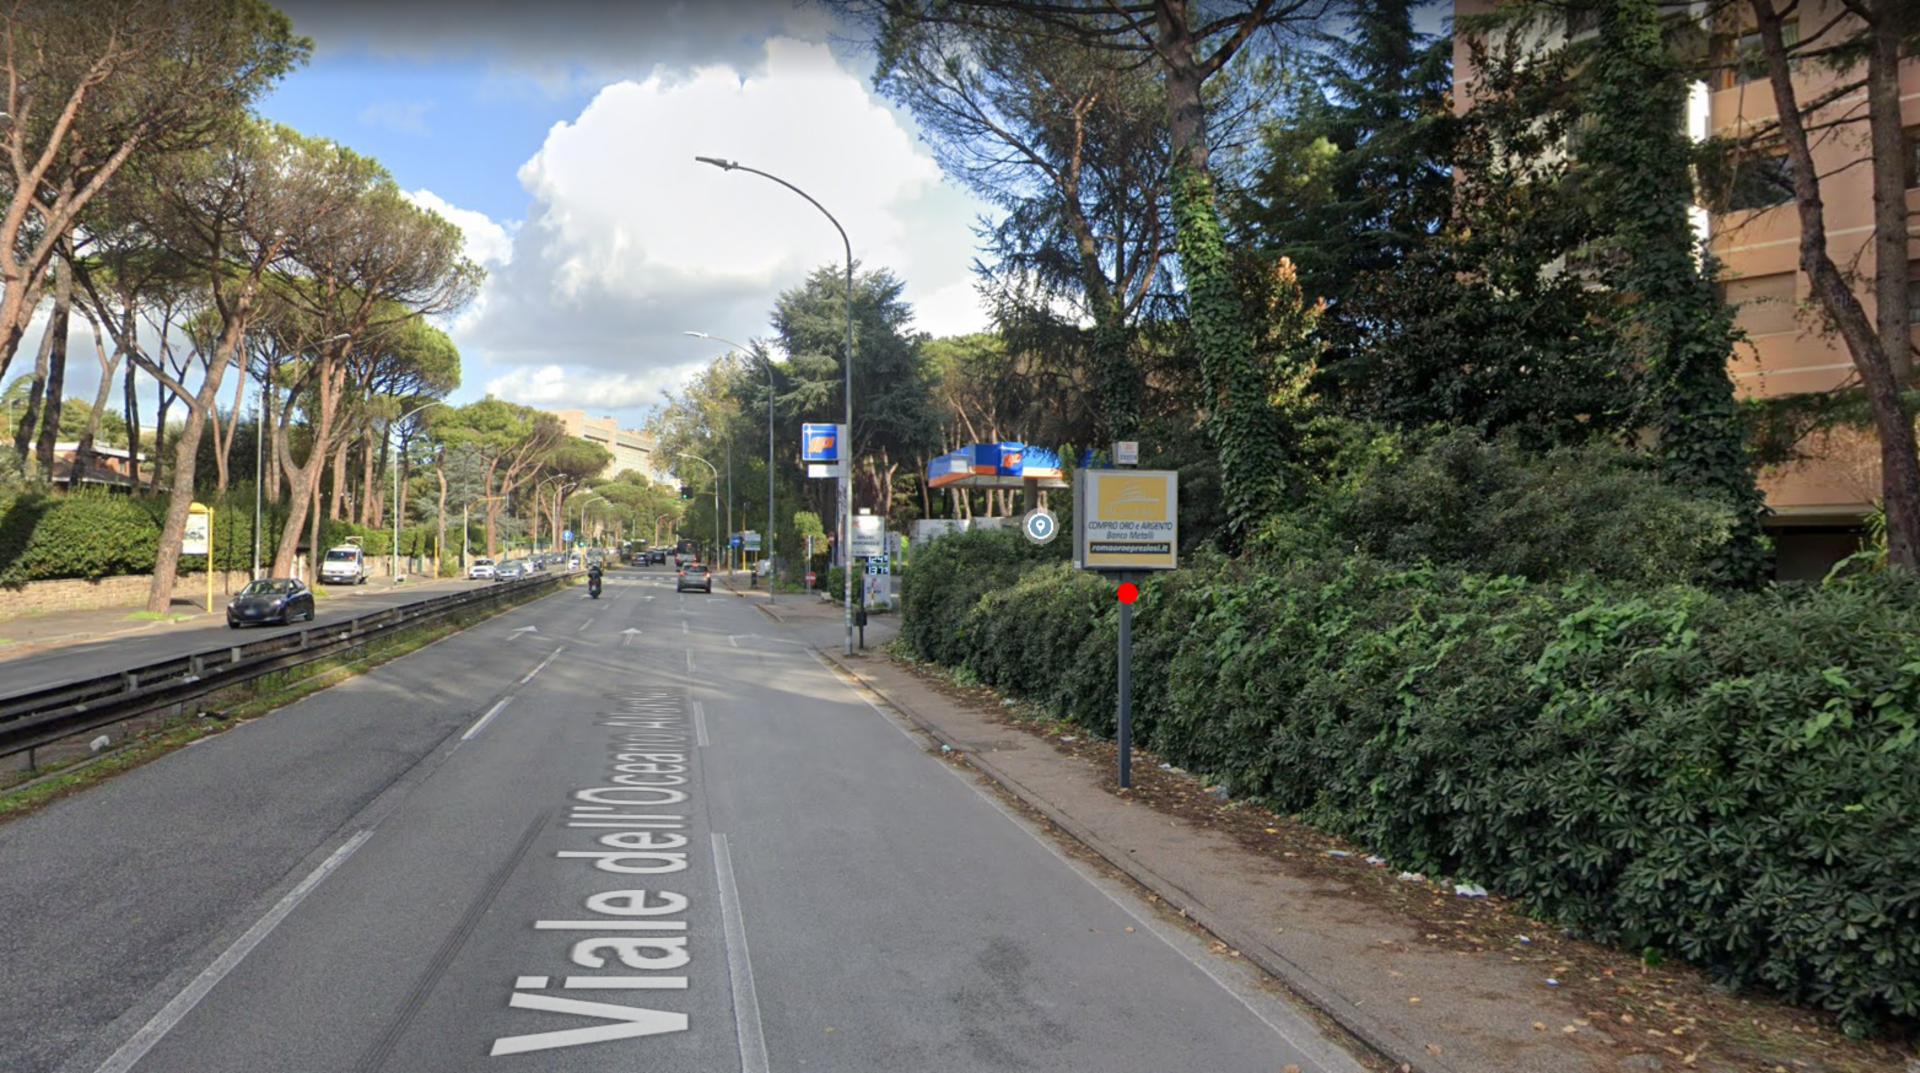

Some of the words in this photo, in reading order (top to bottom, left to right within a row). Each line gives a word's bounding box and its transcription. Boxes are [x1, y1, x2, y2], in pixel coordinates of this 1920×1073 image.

[1088, 522, 1118, 530] COMPRO
[1119, 522, 1135, 530] ORO
[1140, 522, 1173, 531] ARGENTO
[1129, 531, 1154, 540] Metalli
